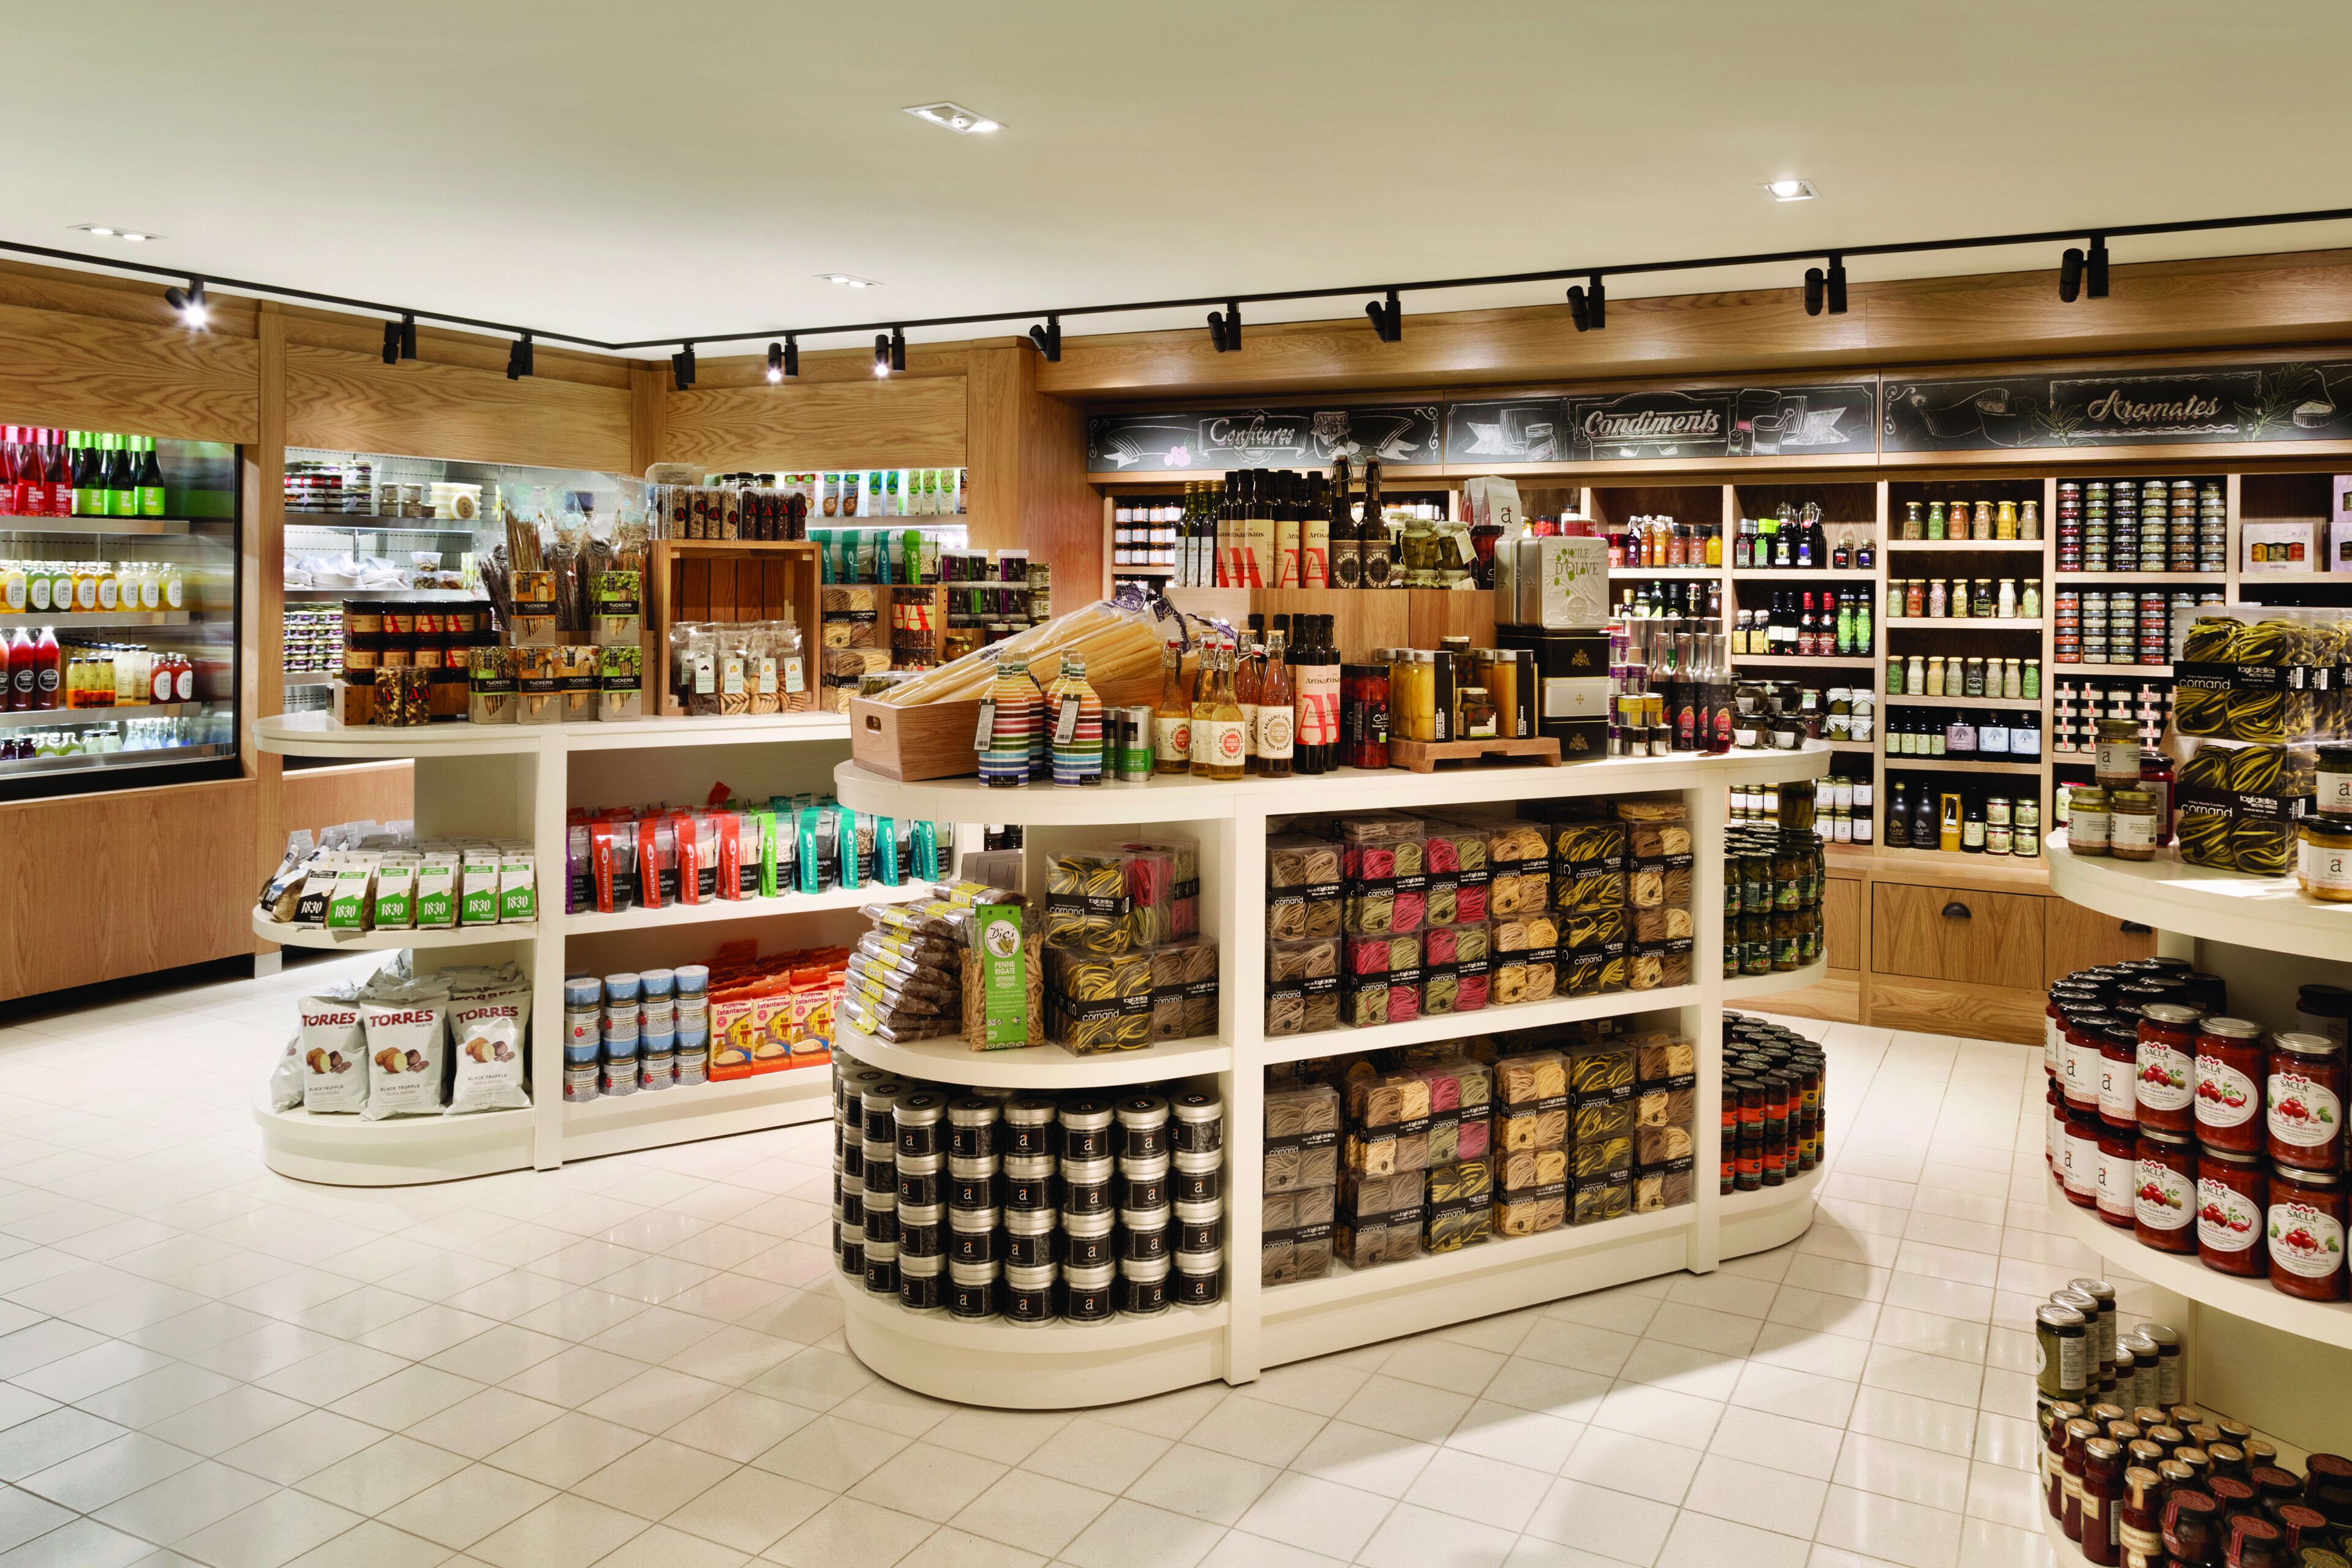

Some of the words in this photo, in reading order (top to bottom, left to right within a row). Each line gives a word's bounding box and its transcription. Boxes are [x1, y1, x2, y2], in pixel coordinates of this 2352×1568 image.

[2087, 390, 2222, 421] Aromates
[1584, 409, 1721, 436] Condiments
[1210, 415, 1294, 447] Confitures
[676, 509, 685, 521] A
[709, 508, 718, 519] A
[748, 503, 757, 516] A
[780, 503, 788, 515] A
[1338, 552, 1353, 564] OLIVE
[1366, 552, 1382, 564] OLIVE
[1568, 548, 1589, 558] HUILE
[1335, 571, 1348, 588] HUILE
[1364, 571, 1377, 587] HUILE
[905, 605, 932, 630] A
[2179, 679, 2230, 689] cornand
[409, 688, 419, 699] A
[1265, 714, 1281, 729] BALSAMIC
[1296, 695, 1327, 745] A
[2101, 749, 2113, 764] a
[2339, 782, 2350, 796] a
[2240, 796, 2278, 805] tagliatelles
[2181, 804, 2233, 817] cornand
[301, 901, 323, 913] 1830
[469, 899, 490, 913] 1830
[507, 895, 528, 910] 1830
[335, 905, 356, 918] 1830
[382, 903, 404, 917] 1830
[424, 902, 445, 916] 1830
[1430, 973, 1456, 982] cornand
[1153, 995, 1183, 1005] cornand
[1272, 992, 1301, 1000] cornand
[456, 1006, 519, 1024] TORRES
[717, 1007, 751, 1016] Istantanea
[1082, 1009, 1119, 1021] cornand
[303, 1012, 356, 1027] TORRES
[370, 1010, 433, 1027] TORRES
[2067, 1059, 2076, 1077] a
[2102, 1073, 2112, 1091] a
[1643, 1088, 1665, 1097] cornand
[1581, 1098, 1609, 1110] cornand
[1512, 1110, 1536, 1119] cornand
[1434, 1120, 1458, 1129] cornand
[2286, 1123, 2321, 1133] ARROSTITO
[906, 1134, 913, 1147] a
[1020, 1133, 1028, 1146] a
[1145, 1136, 1153, 1148] a
[1370, 1134, 1396, 1144] cornand
[1270, 1146, 1298, 1155] cornand
[2064, 1150, 2072, 1168] a
[1642, 1171, 1665, 1180] cornand
[2098, 1168, 2107, 1186] a
[1195, 1180, 1204, 1193] a
[1580, 1183, 1607, 1194] cornand
[964, 1188, 972, 1199] a
[1509, 1197, 1534, 1206] cornand
[1436, 1208, 1465, 1221] cornand
[1359, 1223, 1387, 1234] cornand
[1088, 1245, 1096, 1257] a
[1264, 1240, 1293, 1250] cornand
[2294, 1253, 2329, 1263] ARROSTITO
[1020, 1298, 1028, 1311] a
